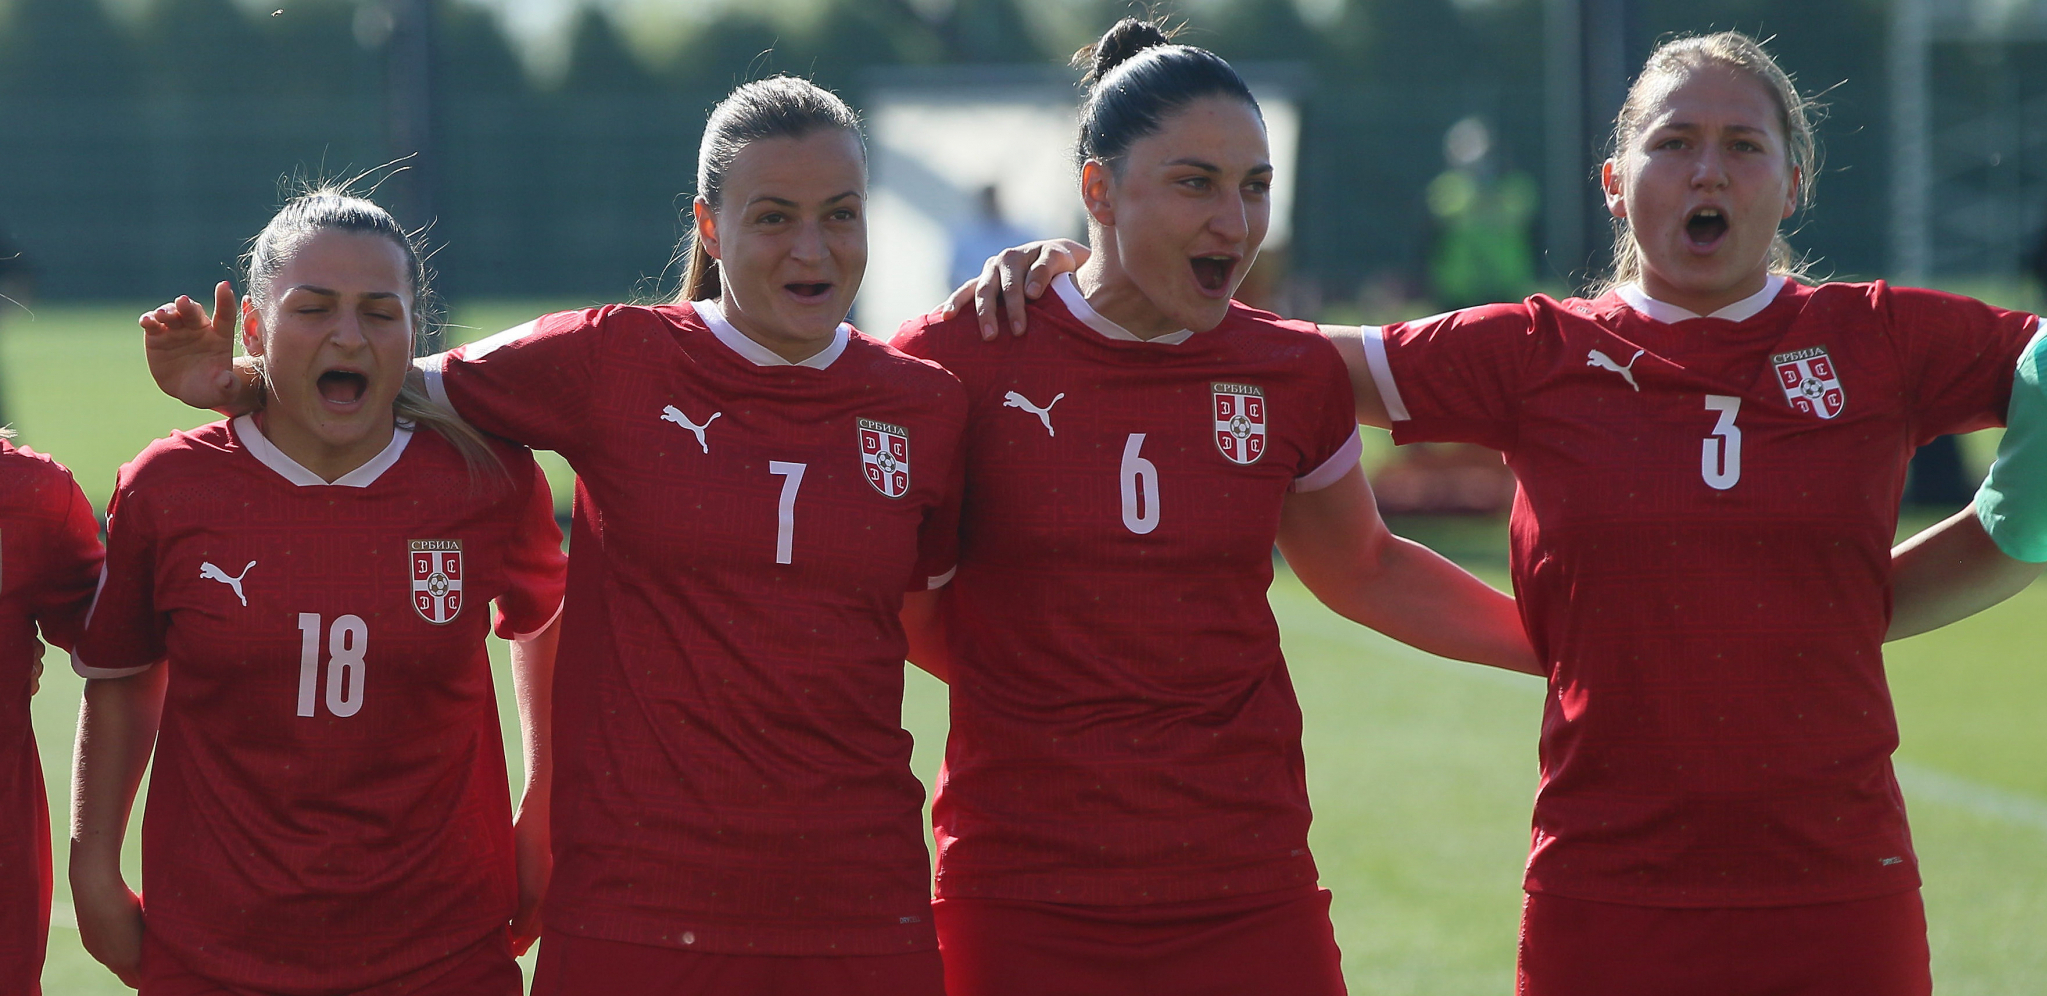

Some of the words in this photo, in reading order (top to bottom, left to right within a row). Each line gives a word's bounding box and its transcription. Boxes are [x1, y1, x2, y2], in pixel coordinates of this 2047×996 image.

[1773, 347, 1825, 364] СРБИЈА
[1213, 383, 1262, 396] СРБИЈА
[859, 419, 906, 436] СРБИЈА
[1701, 394, 1742, 490] 3
[1120, 433, 1160, 534] 6
[769, 460, 807, 565] 7
[411, 540, 460, 550] СРБИЈА
[297, 612, 368, 718] 18
